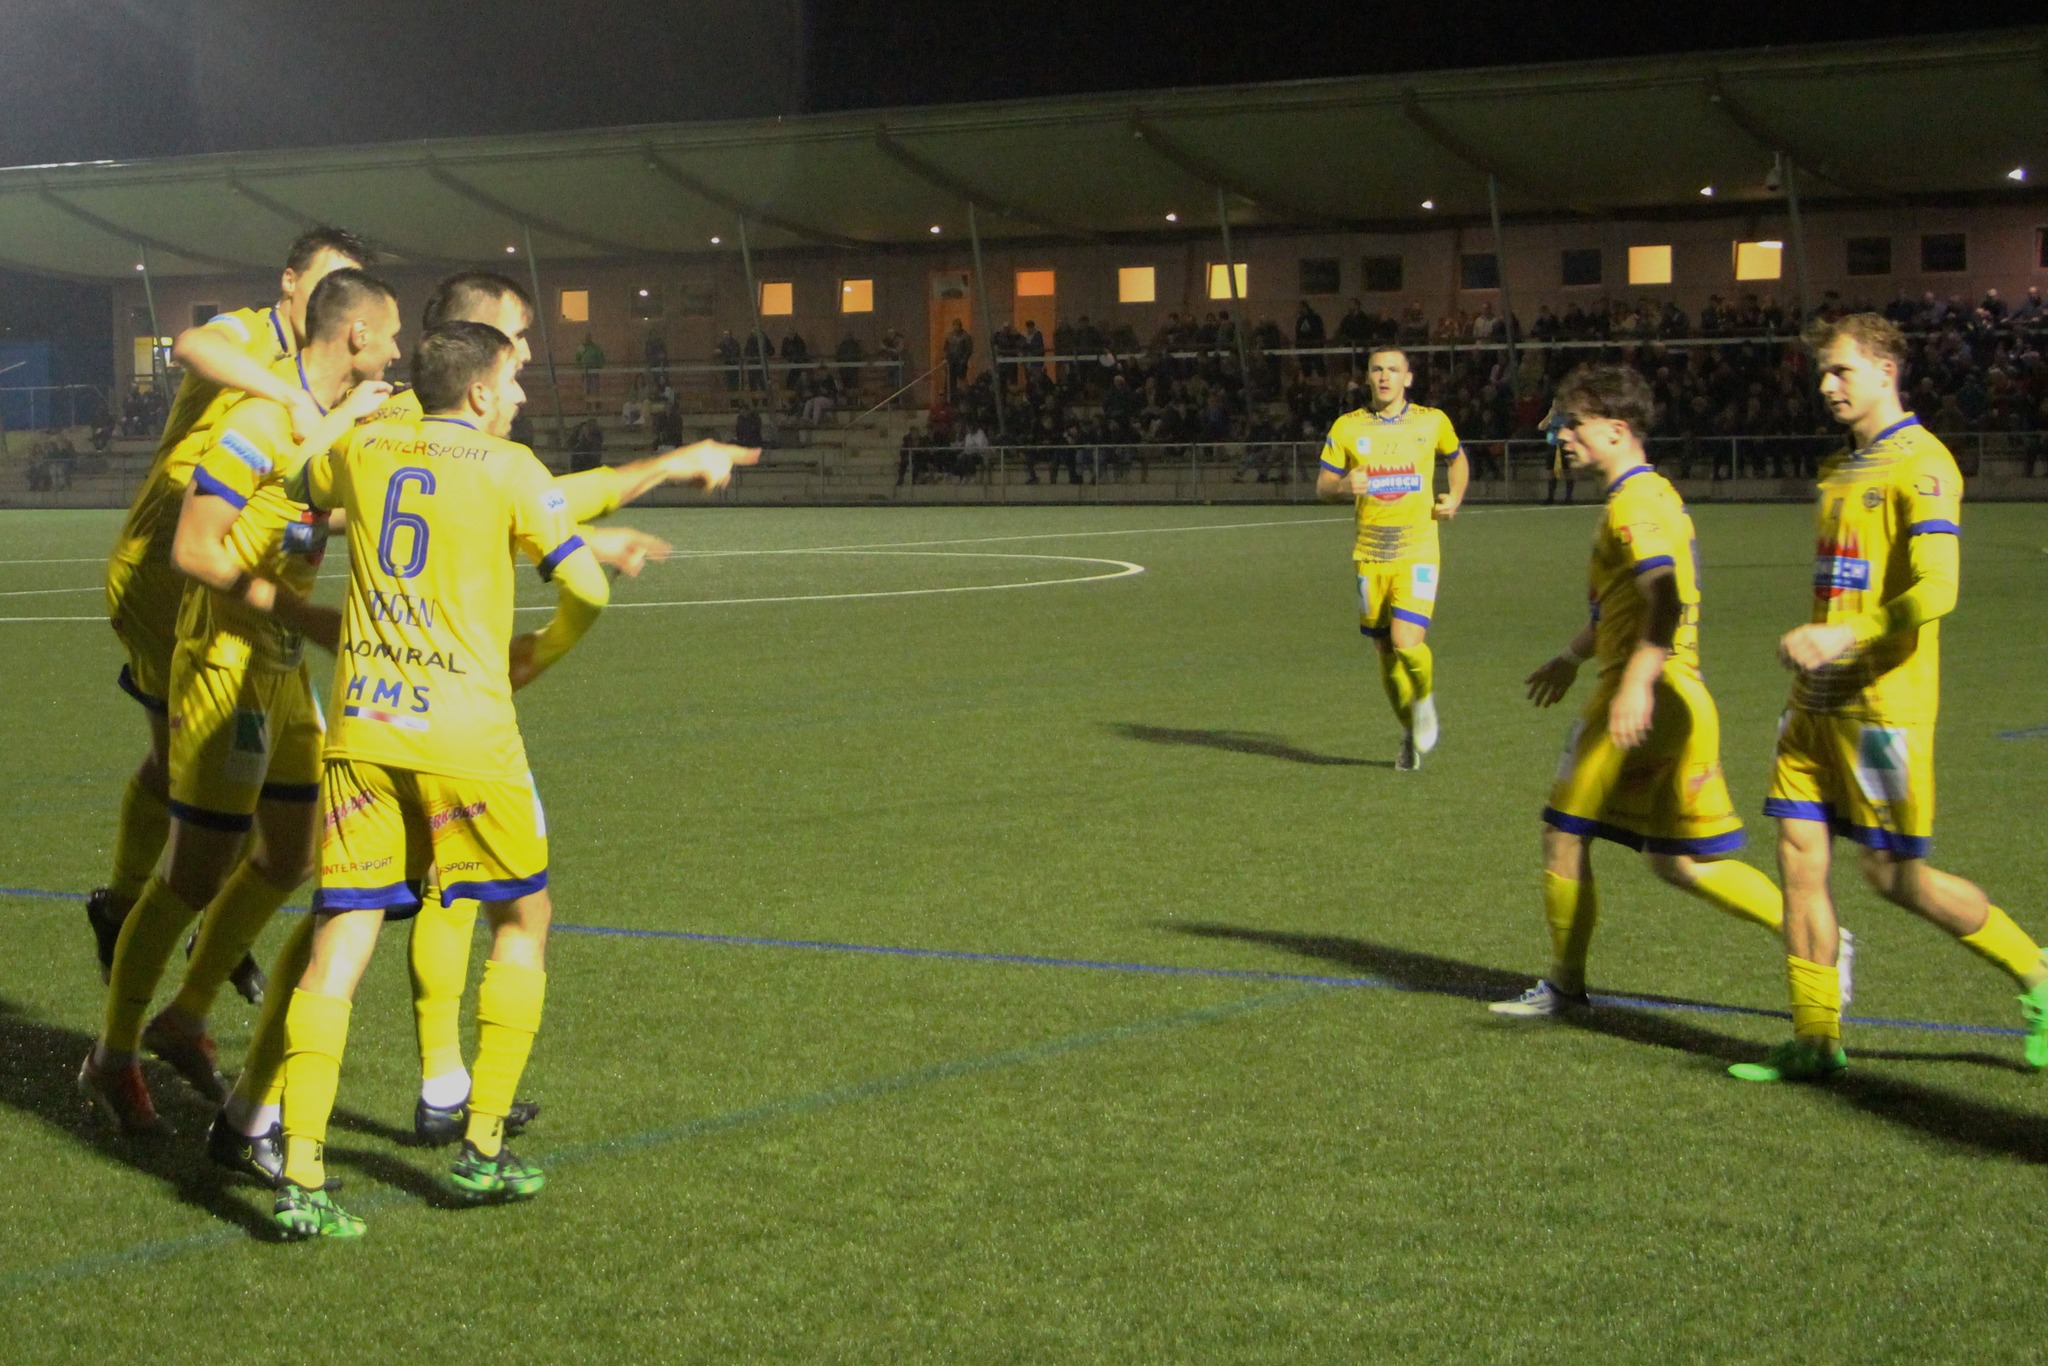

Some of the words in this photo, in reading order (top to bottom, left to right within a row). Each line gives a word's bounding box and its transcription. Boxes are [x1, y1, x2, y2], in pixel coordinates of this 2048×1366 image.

[375, 437, 490, 461] INTERSPORT
[377, 466, 437, 579] 6
[346, 675, 431, 713] HMS
[322, 856, 394, 876] INTERSPORT
